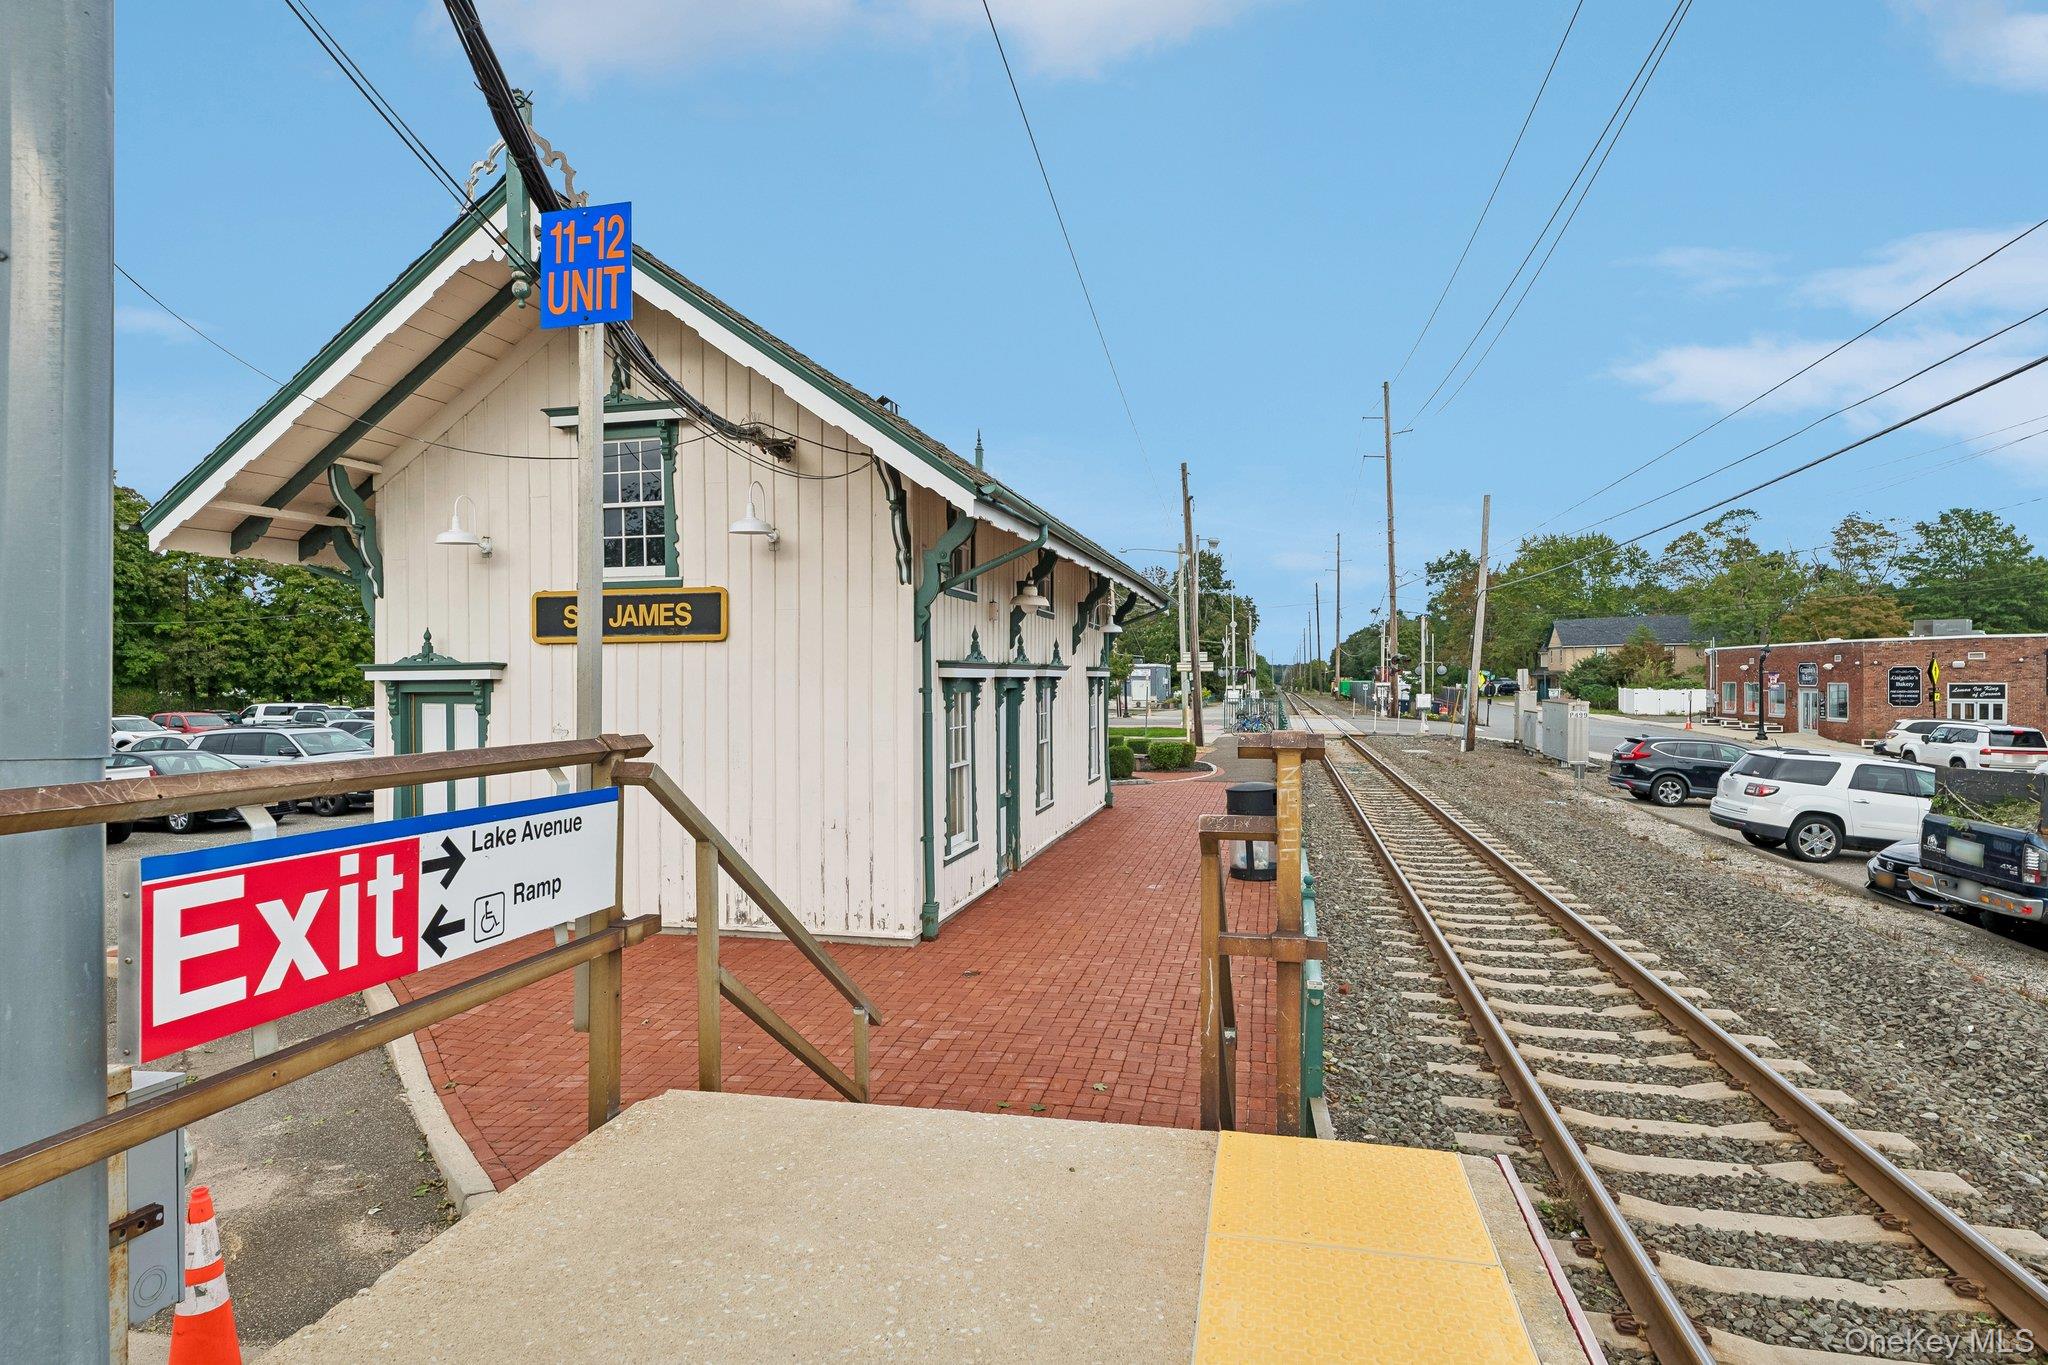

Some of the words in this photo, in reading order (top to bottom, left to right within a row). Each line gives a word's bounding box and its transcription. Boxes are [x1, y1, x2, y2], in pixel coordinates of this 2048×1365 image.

[550, 214, 625, 264] 11-12
[548, 265, 626, 316] UNIT
[608, 602, 692, 628] JAMES
[472, 826, 517, 852] Lake
[521, 816, 582, 842] Avenue
[514, 877, 562, 905] Ramp
[152, 853, 404, 1027] Exit
